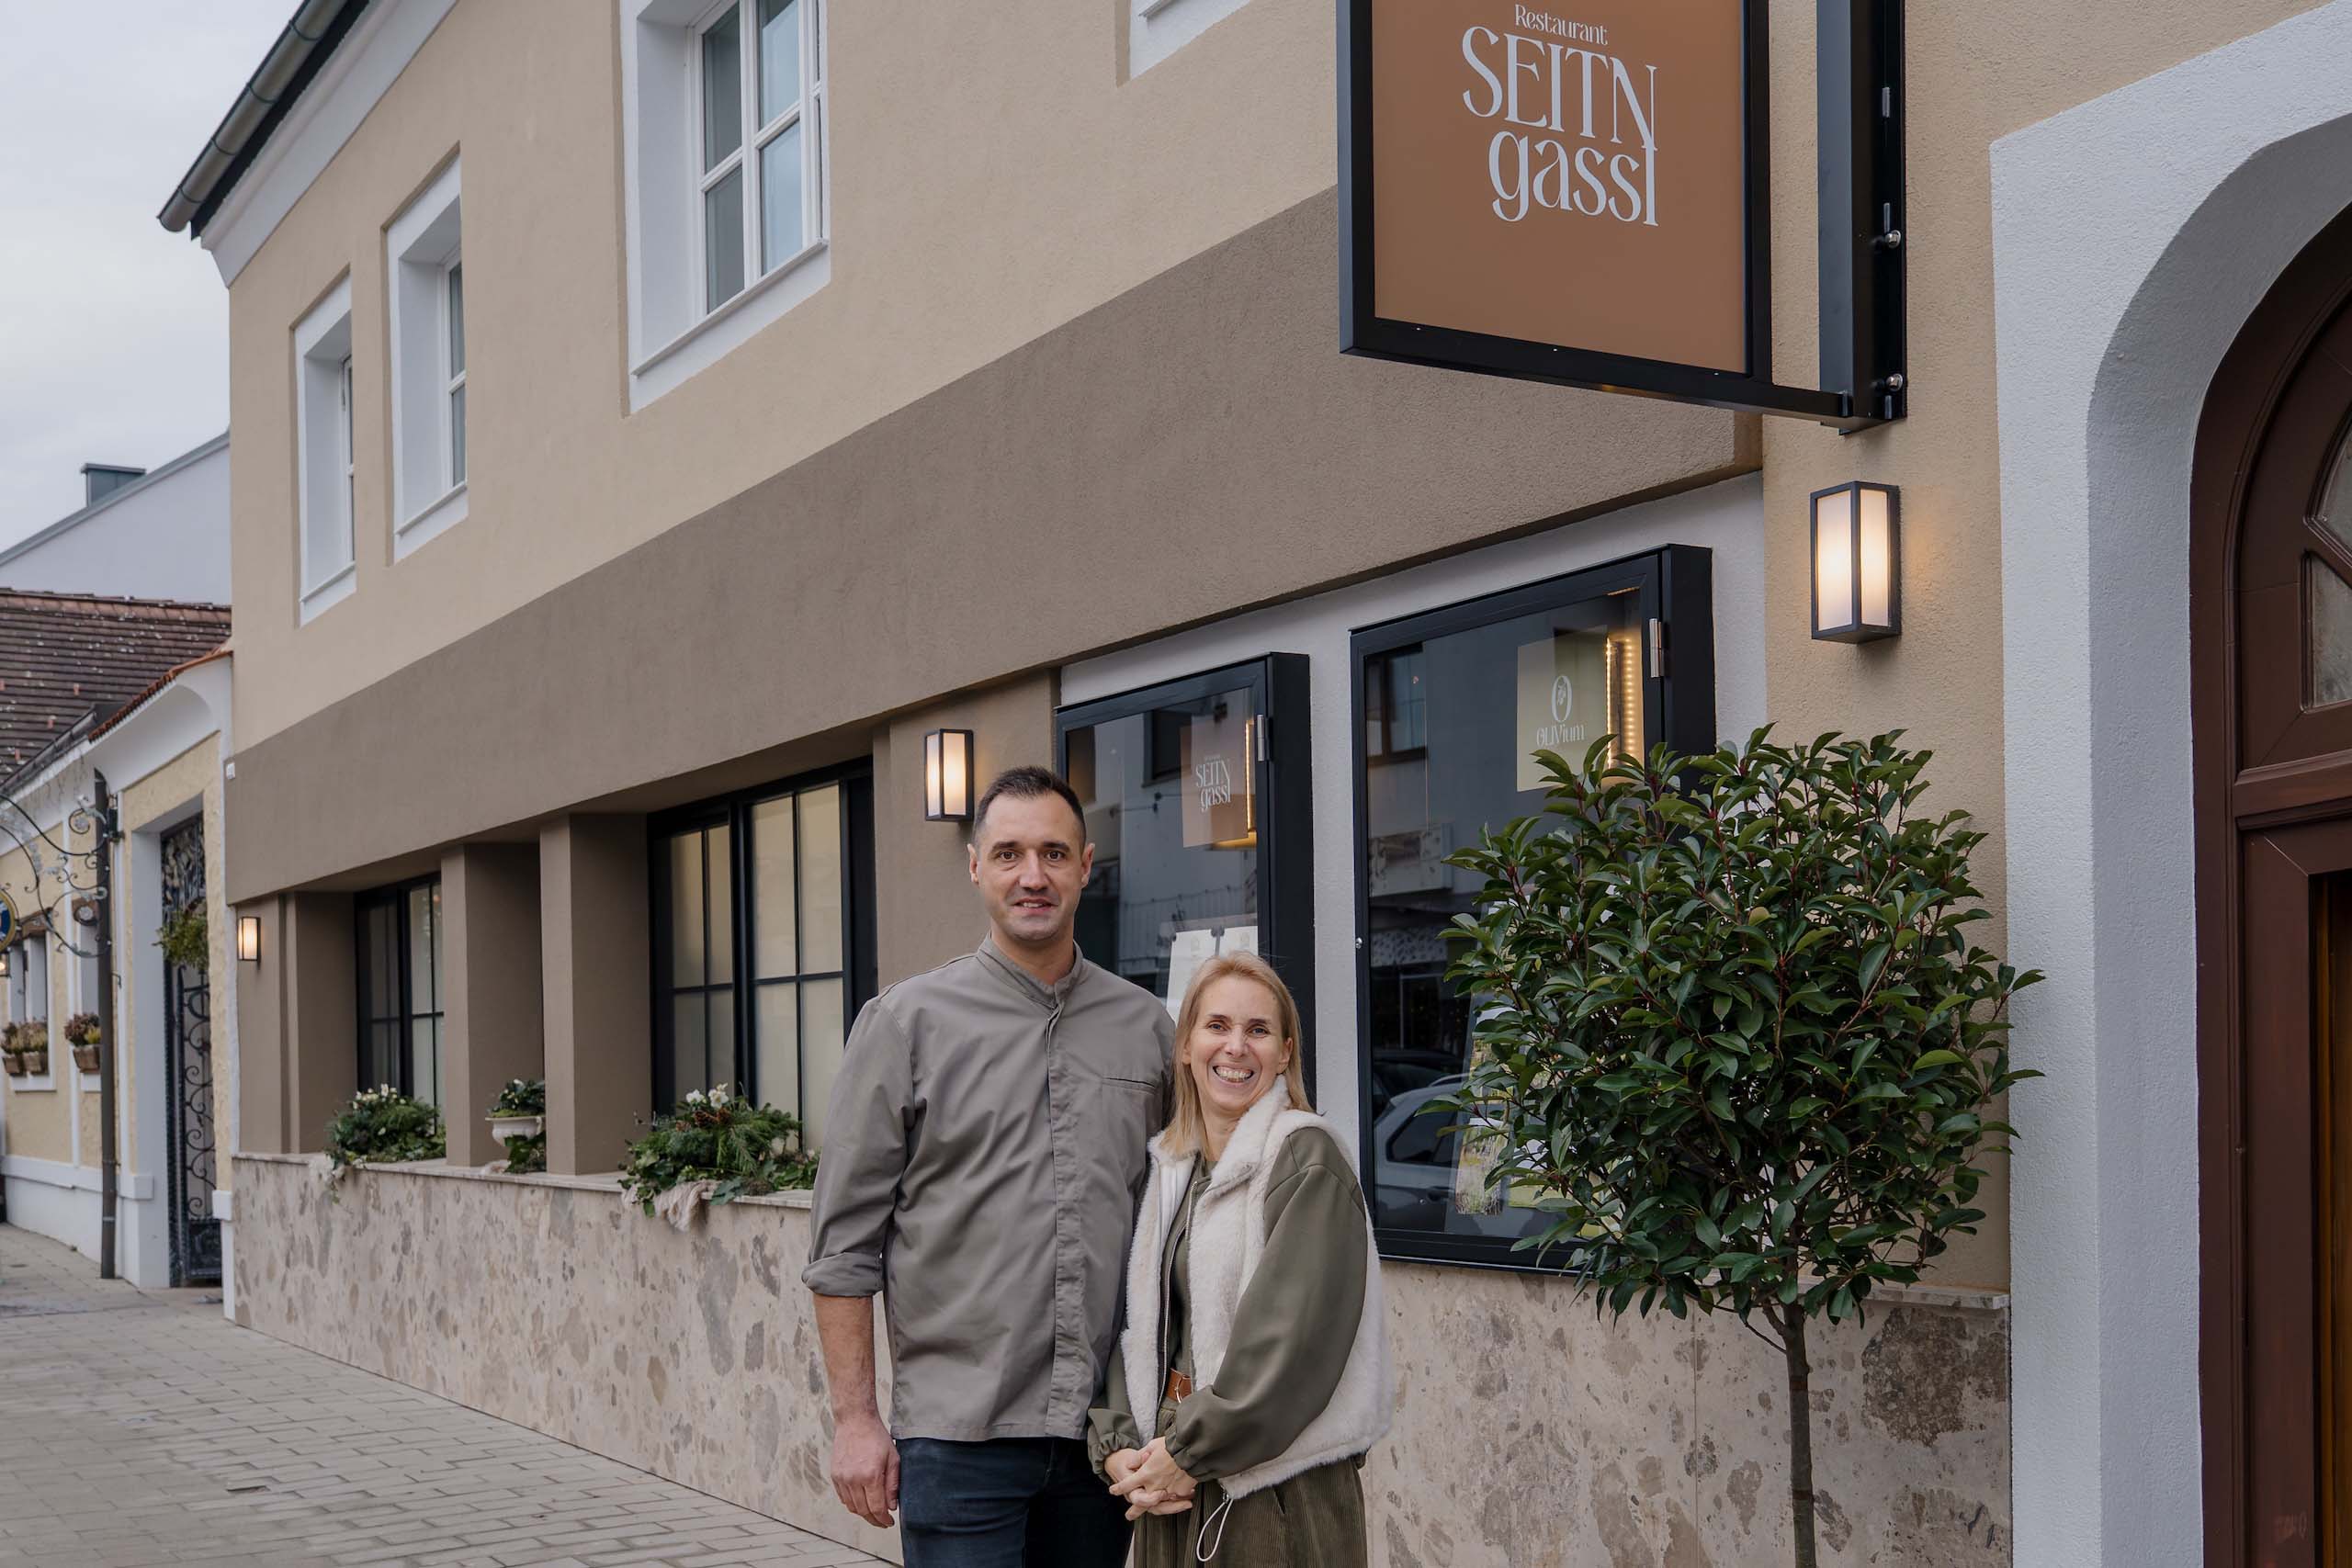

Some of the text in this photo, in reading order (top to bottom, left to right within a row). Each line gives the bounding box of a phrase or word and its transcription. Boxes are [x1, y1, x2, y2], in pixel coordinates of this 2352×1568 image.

[1515, 4, 1608, 46] Restaurant
[1462, 26, 1658, 151] SEITN
[1488, 131, 1658, 226] gassl
[1195, 760, 1230, 788] SEITN
